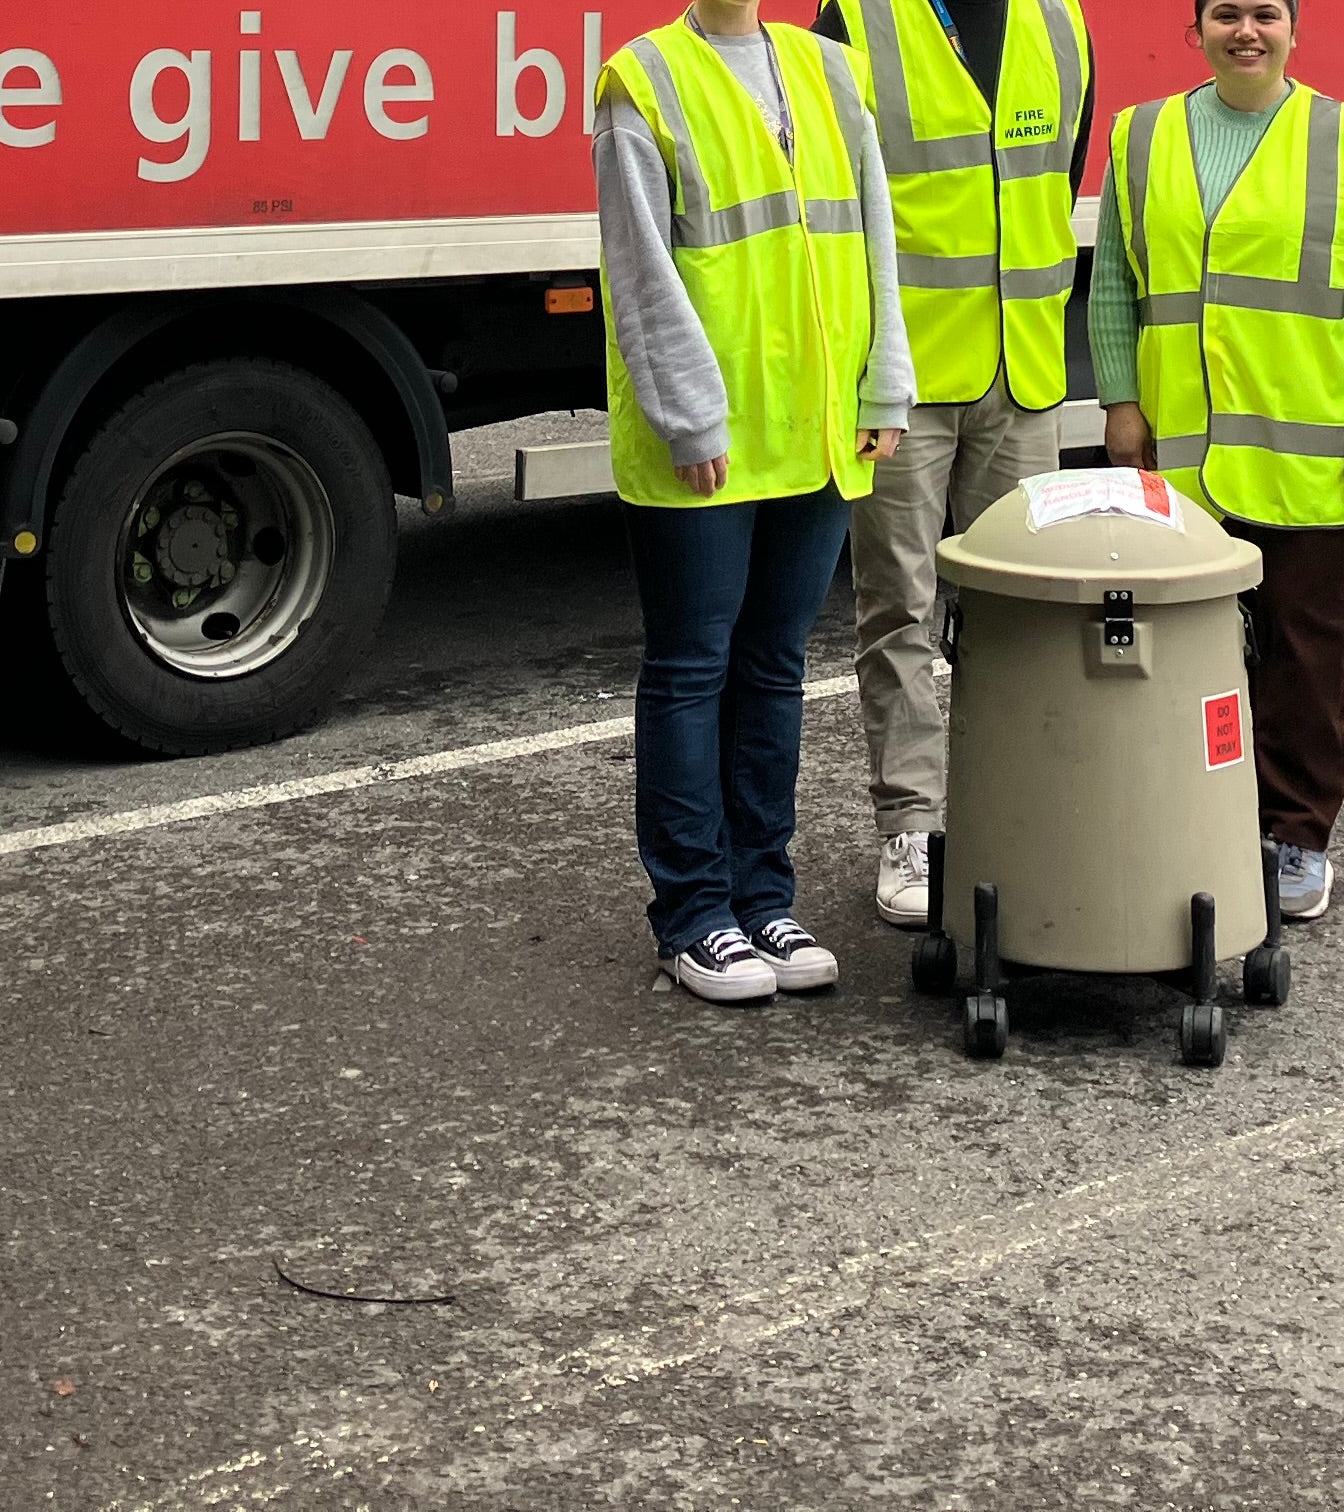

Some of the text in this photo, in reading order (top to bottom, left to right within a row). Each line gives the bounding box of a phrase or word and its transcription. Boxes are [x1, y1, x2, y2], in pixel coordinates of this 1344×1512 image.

[128, 10, 435, 183] give
[1015, 109, 1044, 122] FIRE
[1005, 123, 1053, 139] WARDEN
[253, 199, 293, 213] 85 PSI
[1218, 705, 1230, 718] DO
[1217, 722, 1234, 737] NOT
[1216, 741, 1236, 756] XRAY
